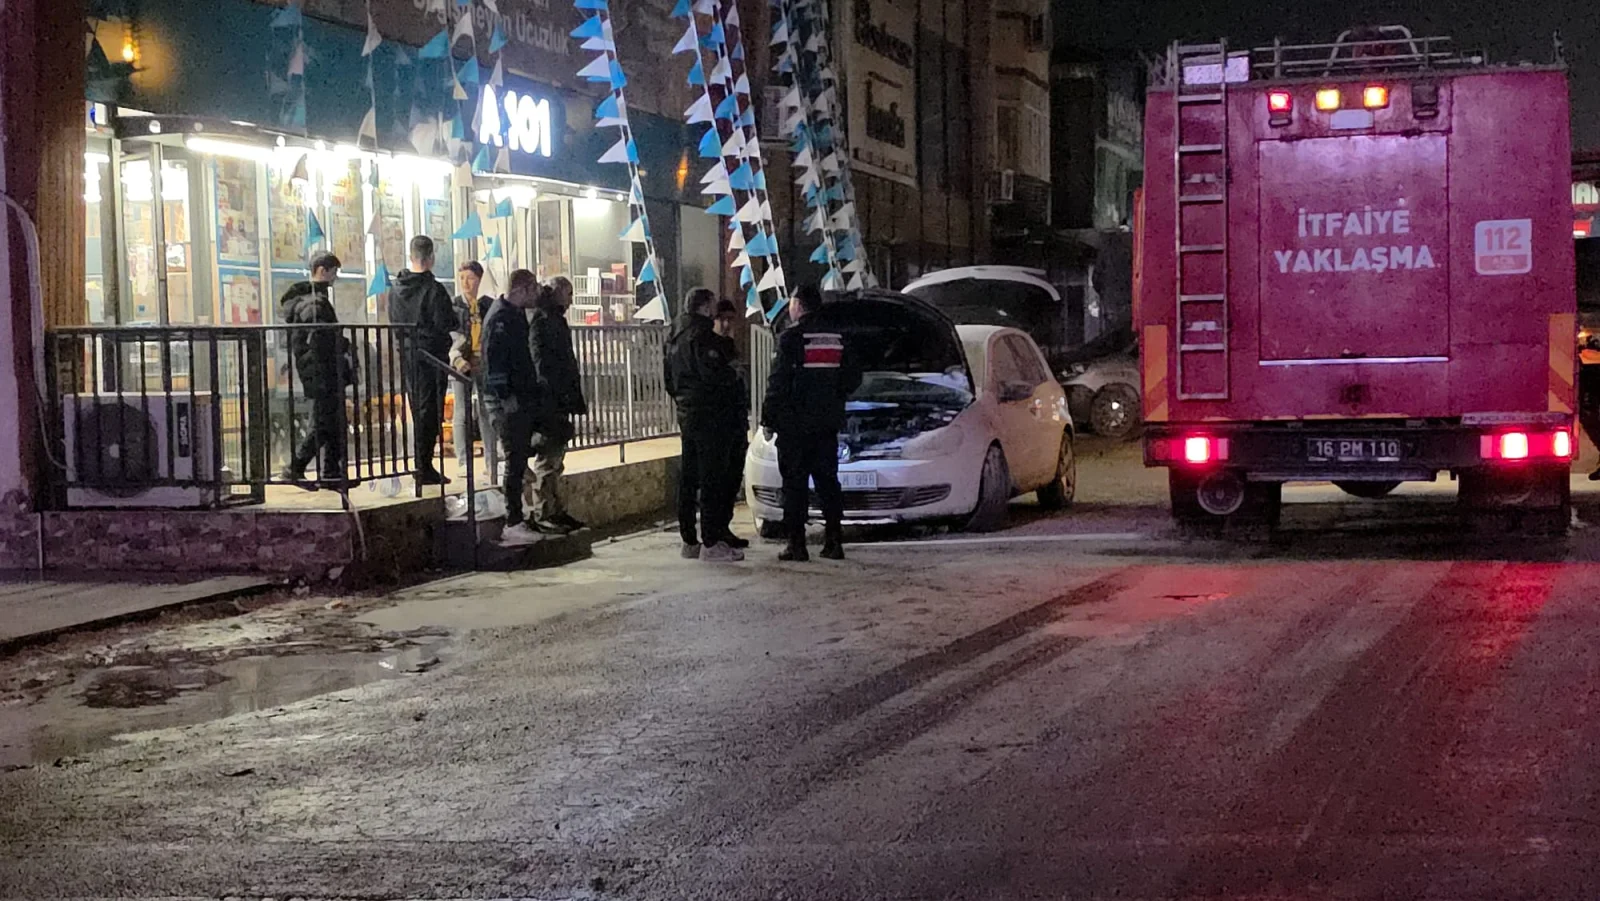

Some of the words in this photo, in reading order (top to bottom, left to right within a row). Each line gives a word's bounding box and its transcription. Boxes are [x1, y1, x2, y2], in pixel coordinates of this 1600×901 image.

[516, 11, 570, 57] Ucuzluk
[1298, 205, 1410, 238] İTFAİYE
[1484, 226, 1522, 252] 112
[1274, 245, 1435, 273] YAKLAŞMA
[1316, 440, 1333, 456] 16
[1340, 441, 1363, 456] PM
[1370, 442, 1397, 456] 110
